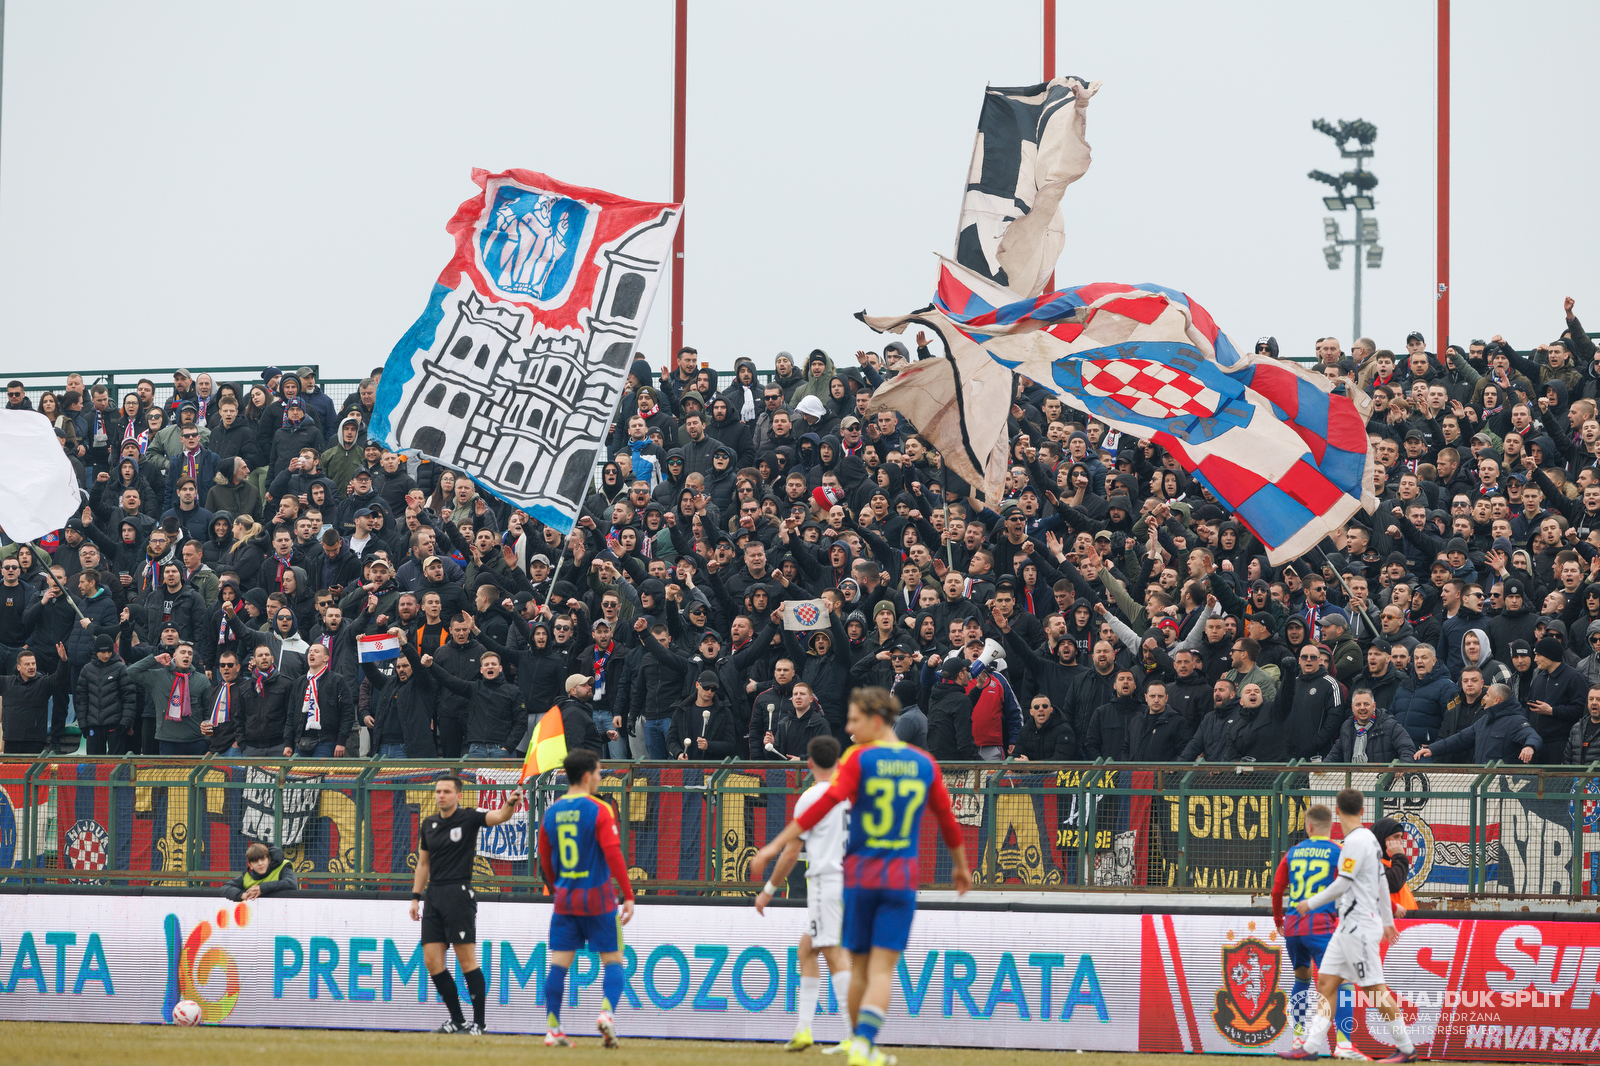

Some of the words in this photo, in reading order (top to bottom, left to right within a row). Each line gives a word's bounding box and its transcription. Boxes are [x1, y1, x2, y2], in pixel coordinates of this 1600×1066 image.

[555, 810, 580, 824] HUGO
[862, 778, 927, 838] 37
[557, 824, 579, 869] 6
[1293, 847, 1331, 859] HRGOVIĆ
[1290, 859, 1330, 900] 32
[0, 931, 115, 995] ATA
[896, 949, 1110, 1022] VRATA
